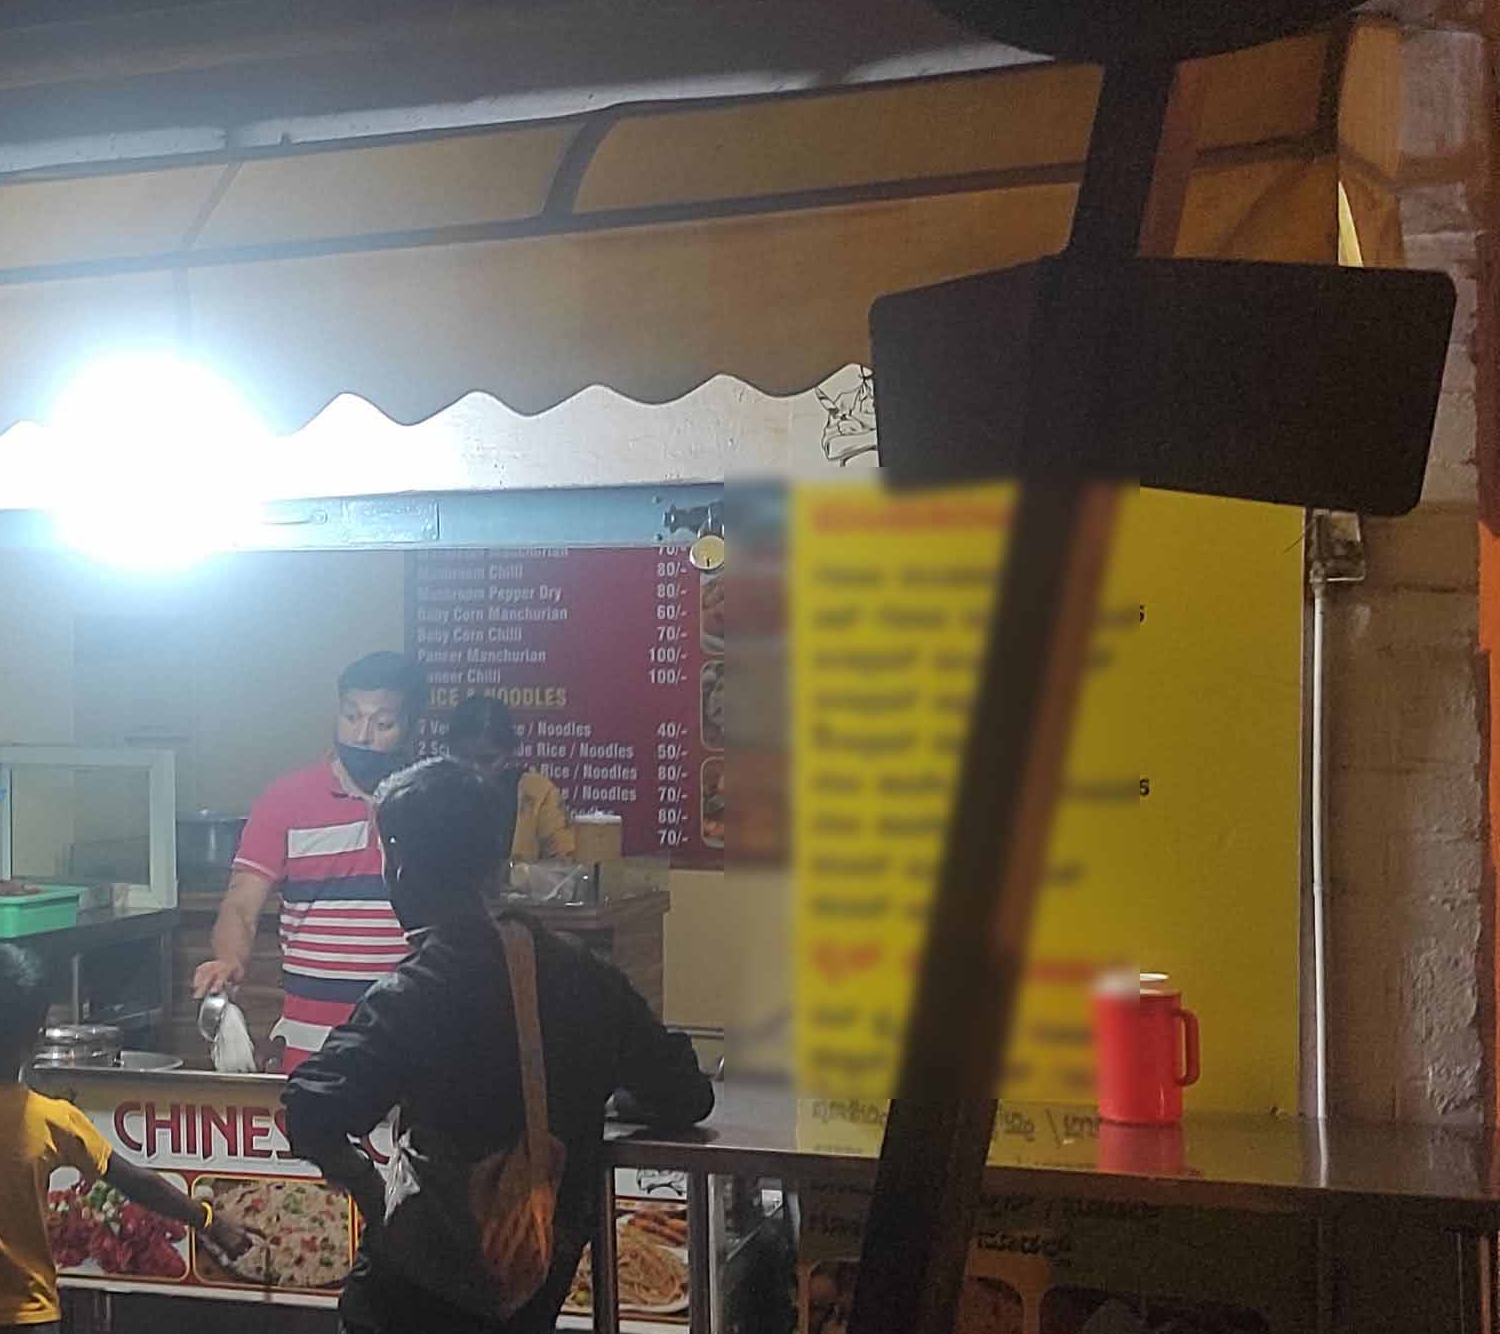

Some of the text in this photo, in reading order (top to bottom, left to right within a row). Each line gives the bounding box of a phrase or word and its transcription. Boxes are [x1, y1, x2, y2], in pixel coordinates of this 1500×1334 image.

[489, 564, 524, 580] Chilli
[488, 586, 535, 603] Pepper
[539, 584, 563, 603] Dry
[453, 607, 484, 620] Corn
[488, 606, 569, 621] Manchurian
[453, 628, 484, 642] Corn
[488, 627, 522, 642] Chilli
[657, 626, 688, 641] 70/-
[417, 648, 688, 663] Paneer Manchurian 100/-
[466, 669, 501, 684] Chilli
[649, 668, 688, 684] 100/-
[538, 721, 592, 737] Noodles
[657, 722, 688, 738] 40/-
[537, 743, 567, 757] Rice
[579, 742, 635, 759] Noodles
[540, 764, 570, 780] Rice
[582, 764, 638, 781] Noodles
[582, 785, 638, 802] Noodles
[658, 787, 689, 803] 70/-
[658, 829, 690, 846] 70/-
[112, 1100, 297, 1161] CHINES
